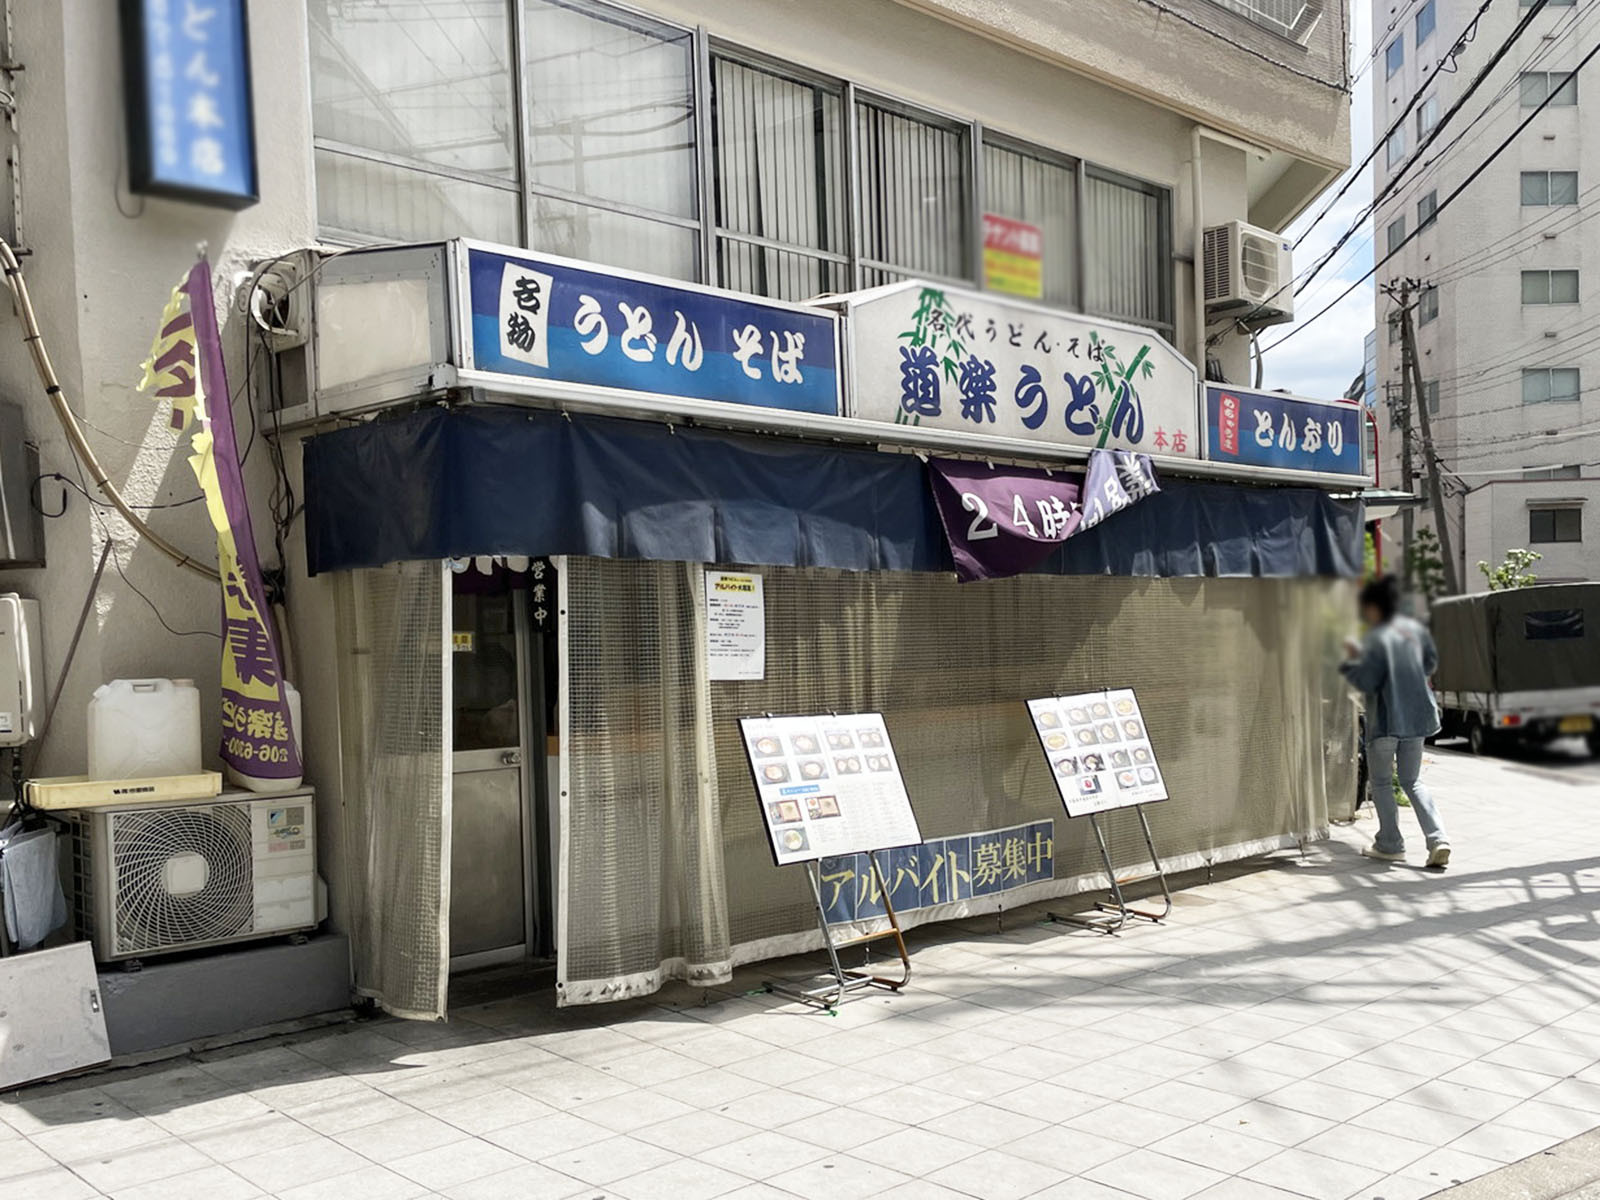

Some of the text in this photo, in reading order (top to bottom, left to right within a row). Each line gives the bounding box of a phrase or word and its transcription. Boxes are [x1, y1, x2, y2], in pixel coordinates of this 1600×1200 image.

[506, 275, 541, 353] 名物
[573, 294, 806, 385] うどん そば
[899, 345, 1146, 445] 道楽うどん
[1253, 408, 1344, 457] どんぶり
[1153, 427, 1188, 454] 本店
[531, 560, 548, 627] 営業中
[820, 831, 1053, 912] アルバイト募集中
